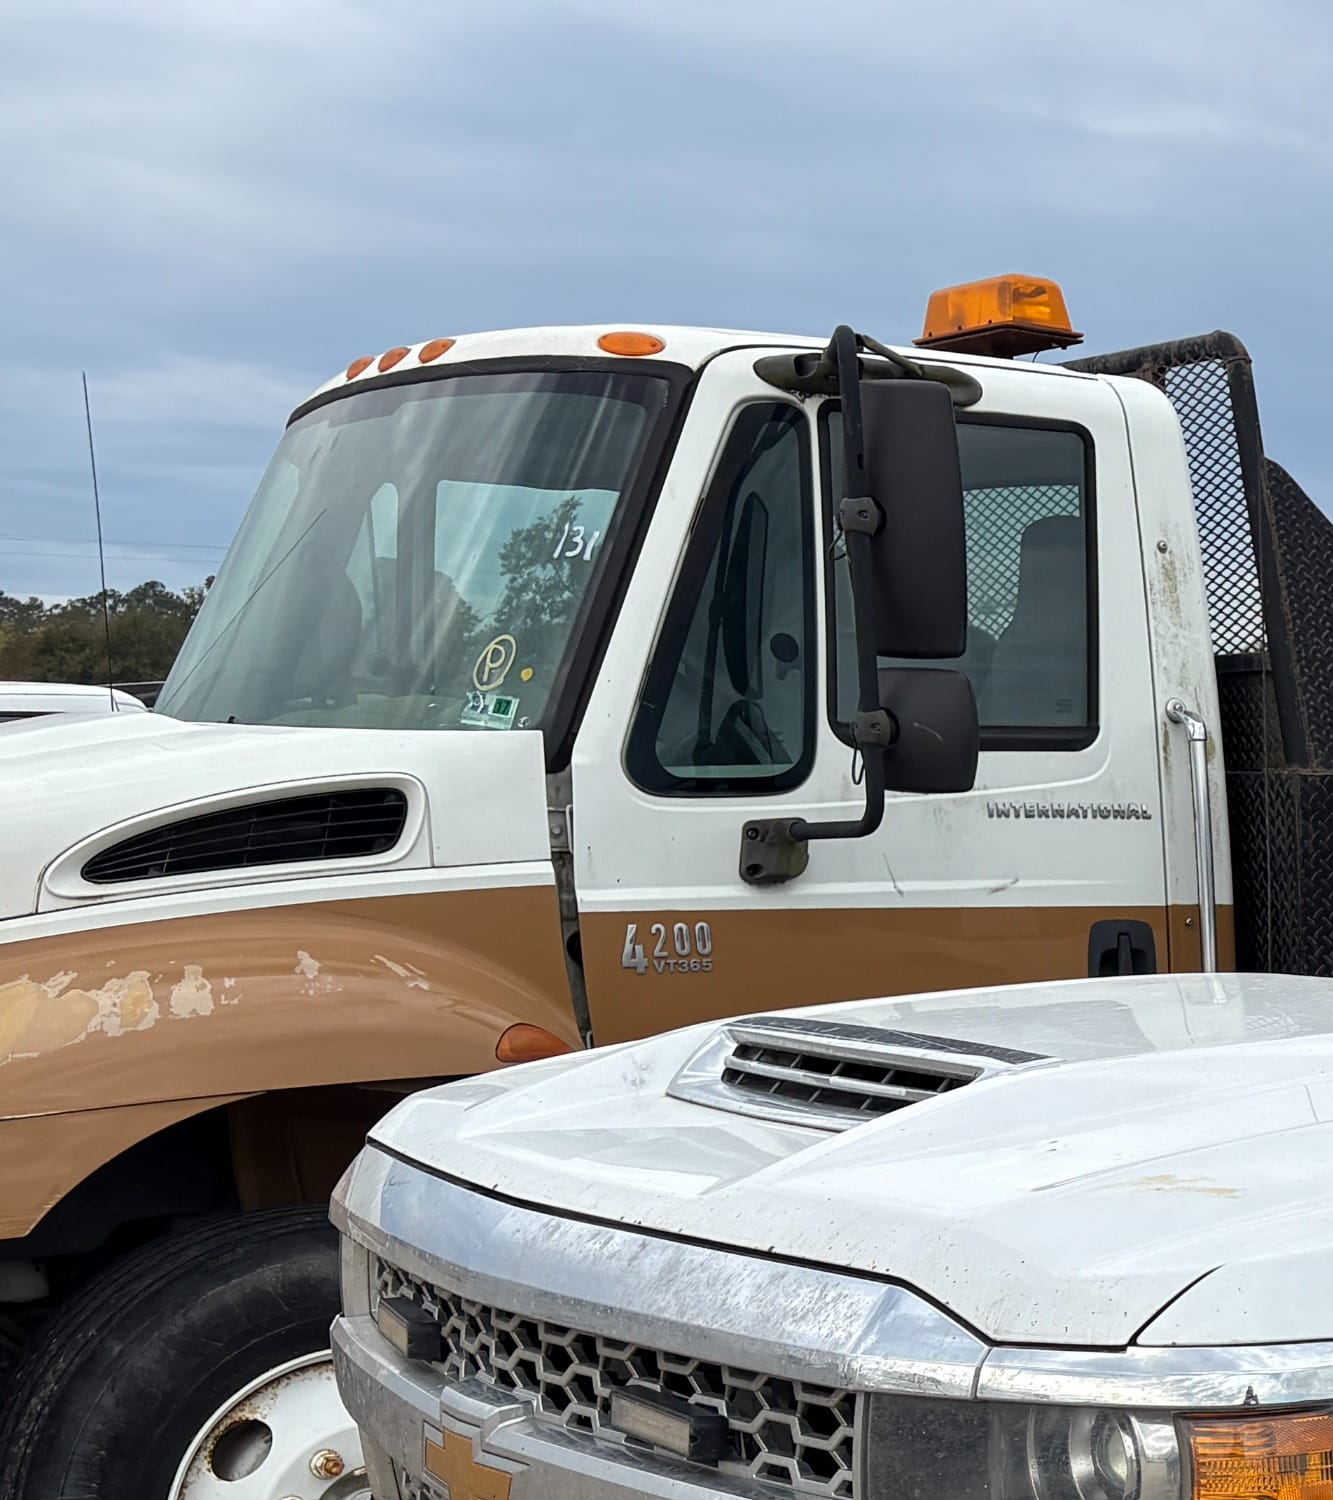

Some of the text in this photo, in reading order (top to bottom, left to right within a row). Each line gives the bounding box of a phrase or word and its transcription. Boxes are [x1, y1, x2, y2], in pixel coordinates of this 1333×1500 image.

[553, 523, 600, 561] 131
[986, 802, 1152, 820] INTERNATIONAL
[621, 921, 713, 975] 4200
[652, 958, 713, 974] VT365
